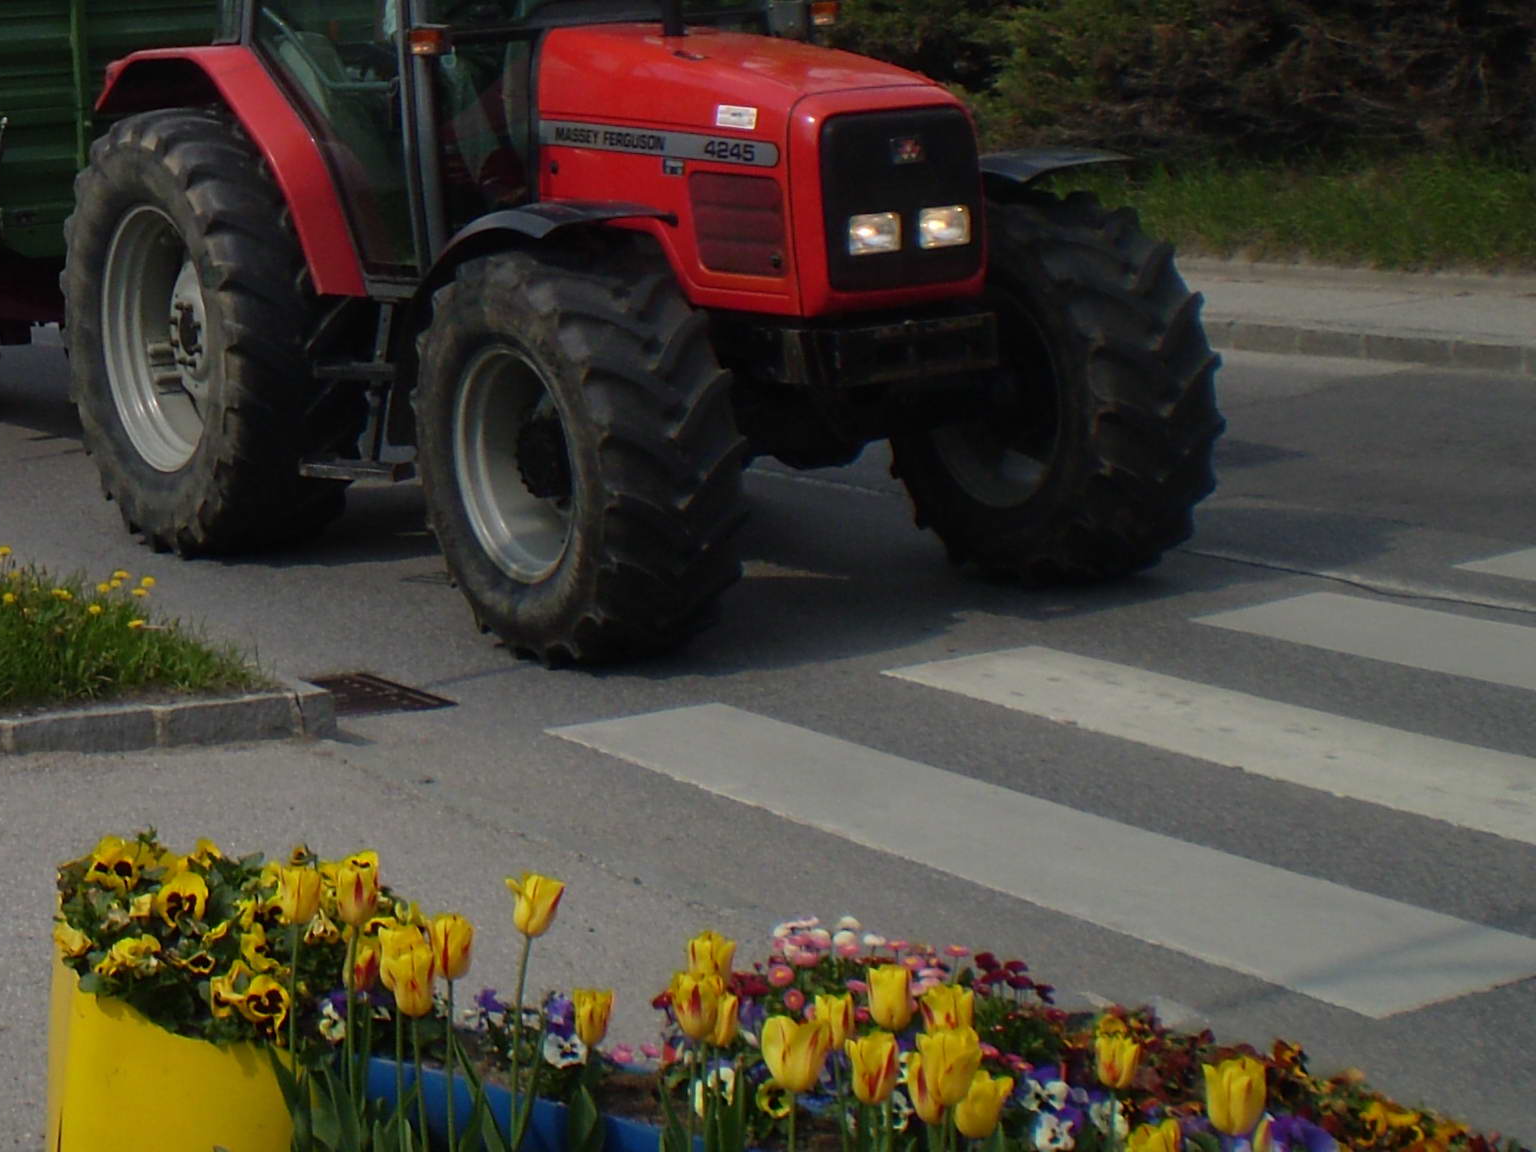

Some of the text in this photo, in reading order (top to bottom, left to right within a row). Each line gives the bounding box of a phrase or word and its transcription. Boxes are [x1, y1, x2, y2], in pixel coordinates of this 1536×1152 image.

[554, 127, 756, 162] MASSEY FERGUSON 4245
